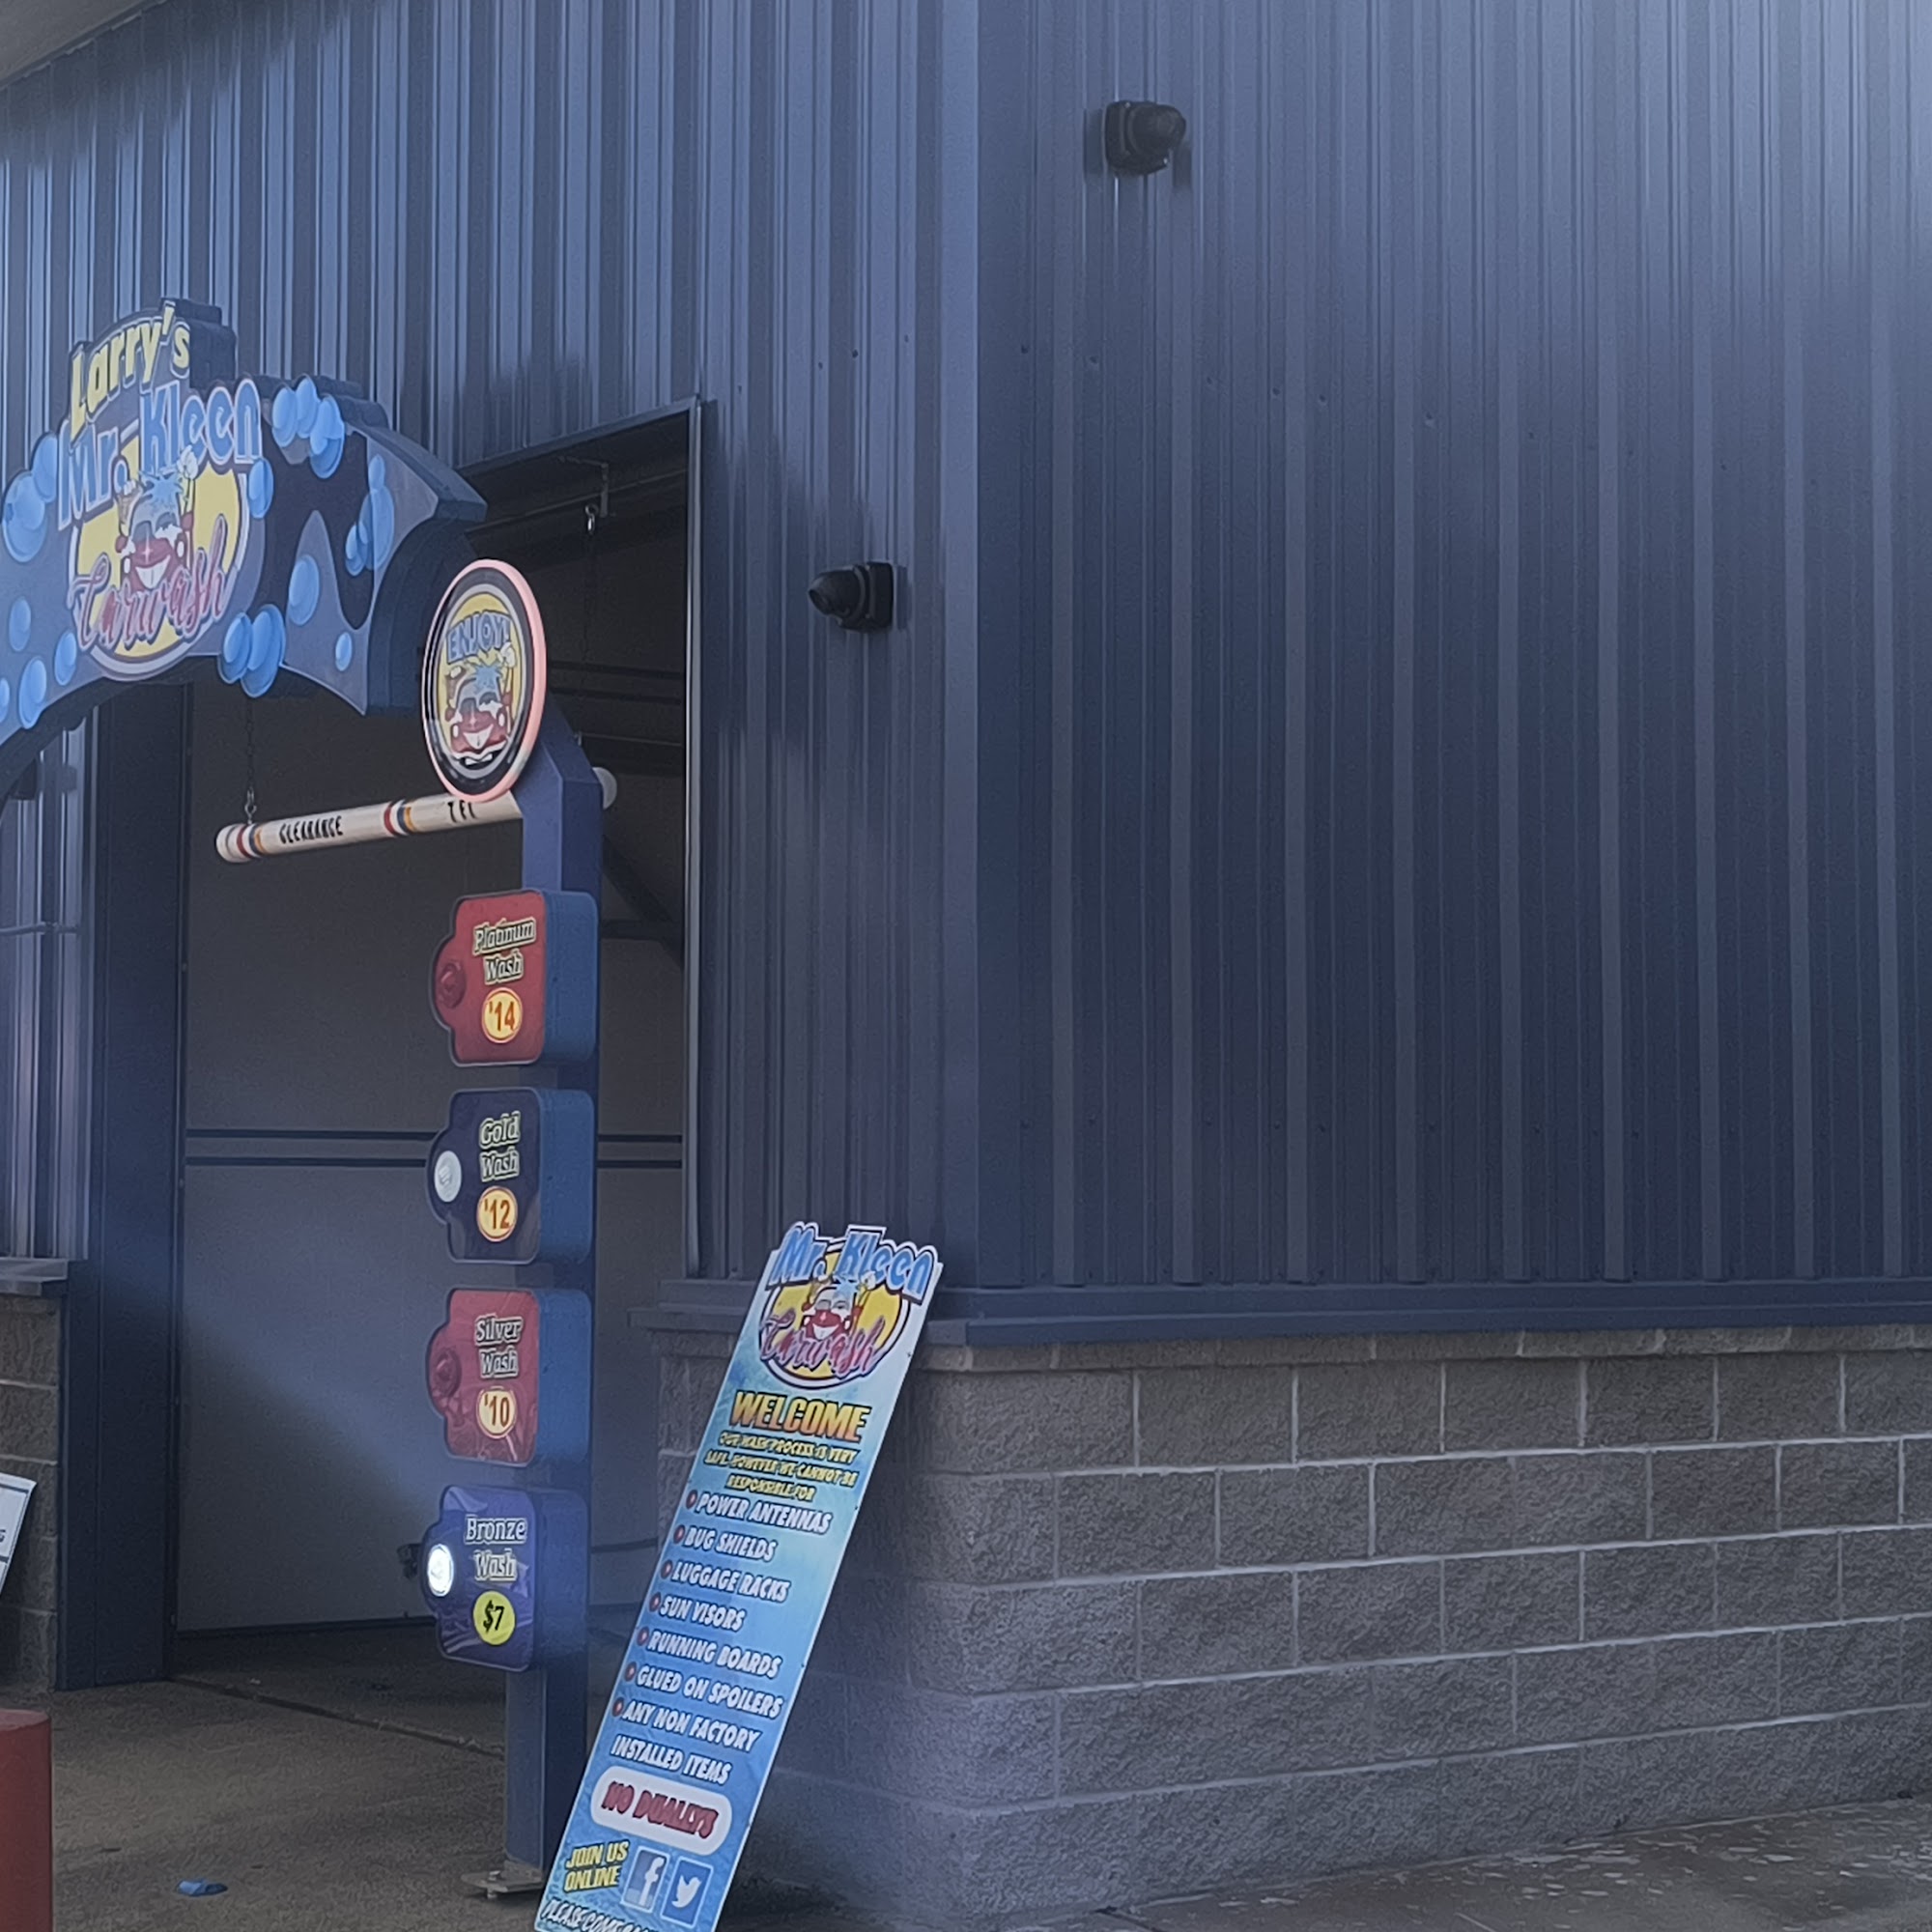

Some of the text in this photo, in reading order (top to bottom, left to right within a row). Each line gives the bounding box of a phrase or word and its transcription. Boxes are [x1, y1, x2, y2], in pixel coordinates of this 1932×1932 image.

[71, 305, 191, 442] Larry's
[58, 379, 263, 529] Mr. Kleen
[447, 610, 513, 665] ENJOY!
[279, 815, 343, 844] CLEARANCE
[473, 917, 535, 954] Platinum
[484, 951, 523, 984] Wash
[479, 1111, 520, 1147] Gold
[481, 1147, 519, 1181] Wash
[769, 1223, 935, 1301] Mr. Kleen
[474, 1315, 523, 1346] Silver
[480, 1347, 519, 1378] Wash
[729, 1390, 871, 1442] WELCOME
[770, 1437, 814, 1457] PROCESS
[829, 1447, 859, 1464] VERY
[725, 1473, 795, 1499] RESPONSIBLE
[797, 1463, 842, 1485] CANNOT
[465, 1515, 527, 1545] Bronze
[696, 1492, 833, 1534] POWER ANTENNAS
[684, 1525, 778, 1562] BUG SHIELDS
[474, 1548, 517, 1580] Wash
[671, 1562, 791, 1604] LUGGAGE RACKS
[482, 1599, 505, 1634] $7
[660, 1595, 747, 1632] SUN VISORS
[647, 1629, 782, 1680] RUNNING BOARDS
[636, 1665, 785, 1719] GLUED ON SPOILERS
[622, 1700, 763, 1751] ANY NON FACTORY
[610, 1734, 733, 1785] INSTALLED ITEMS
[601, 1780, 635, 1815] NO
[566, 1841, 630, 1869] JOIN US
[564, 1864, 623, 1892] ONLINE
[541, 1896, 585, 1928] PLEASE
